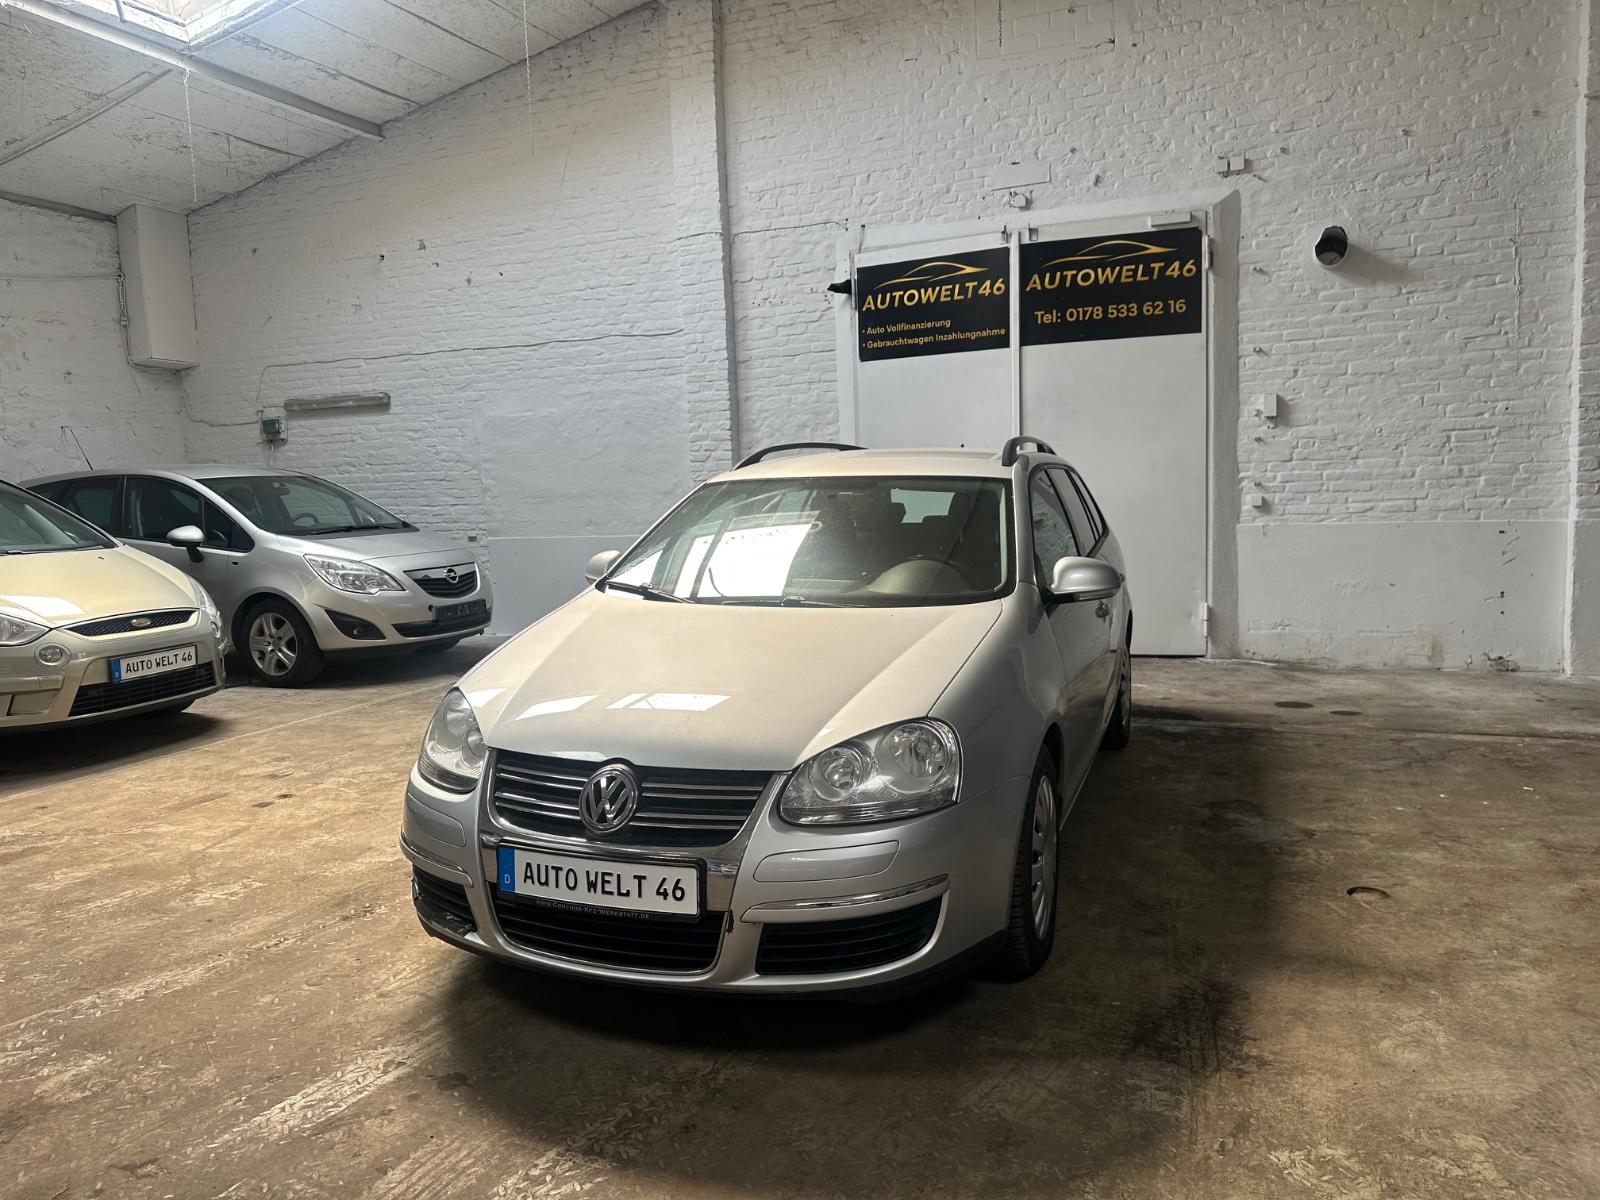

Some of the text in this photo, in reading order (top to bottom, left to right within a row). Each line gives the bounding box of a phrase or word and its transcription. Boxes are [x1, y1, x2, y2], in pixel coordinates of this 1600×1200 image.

[1034, 299, 1186, 325] Tel: 0178 533 62 16
[866, 319, 951, 335] Auto Vollfinanzierung
[867, 327, 1006, 349] Gebrauchtwagen Inzahlungnahme
[125, 659, 153, 674] AUTO
[155, 653, 179, 668] WELT
[181, 651, 193, 662] 46
[504, 873, 511, 884] D
[523, 861, 686, 901] AUTO WELT 46
